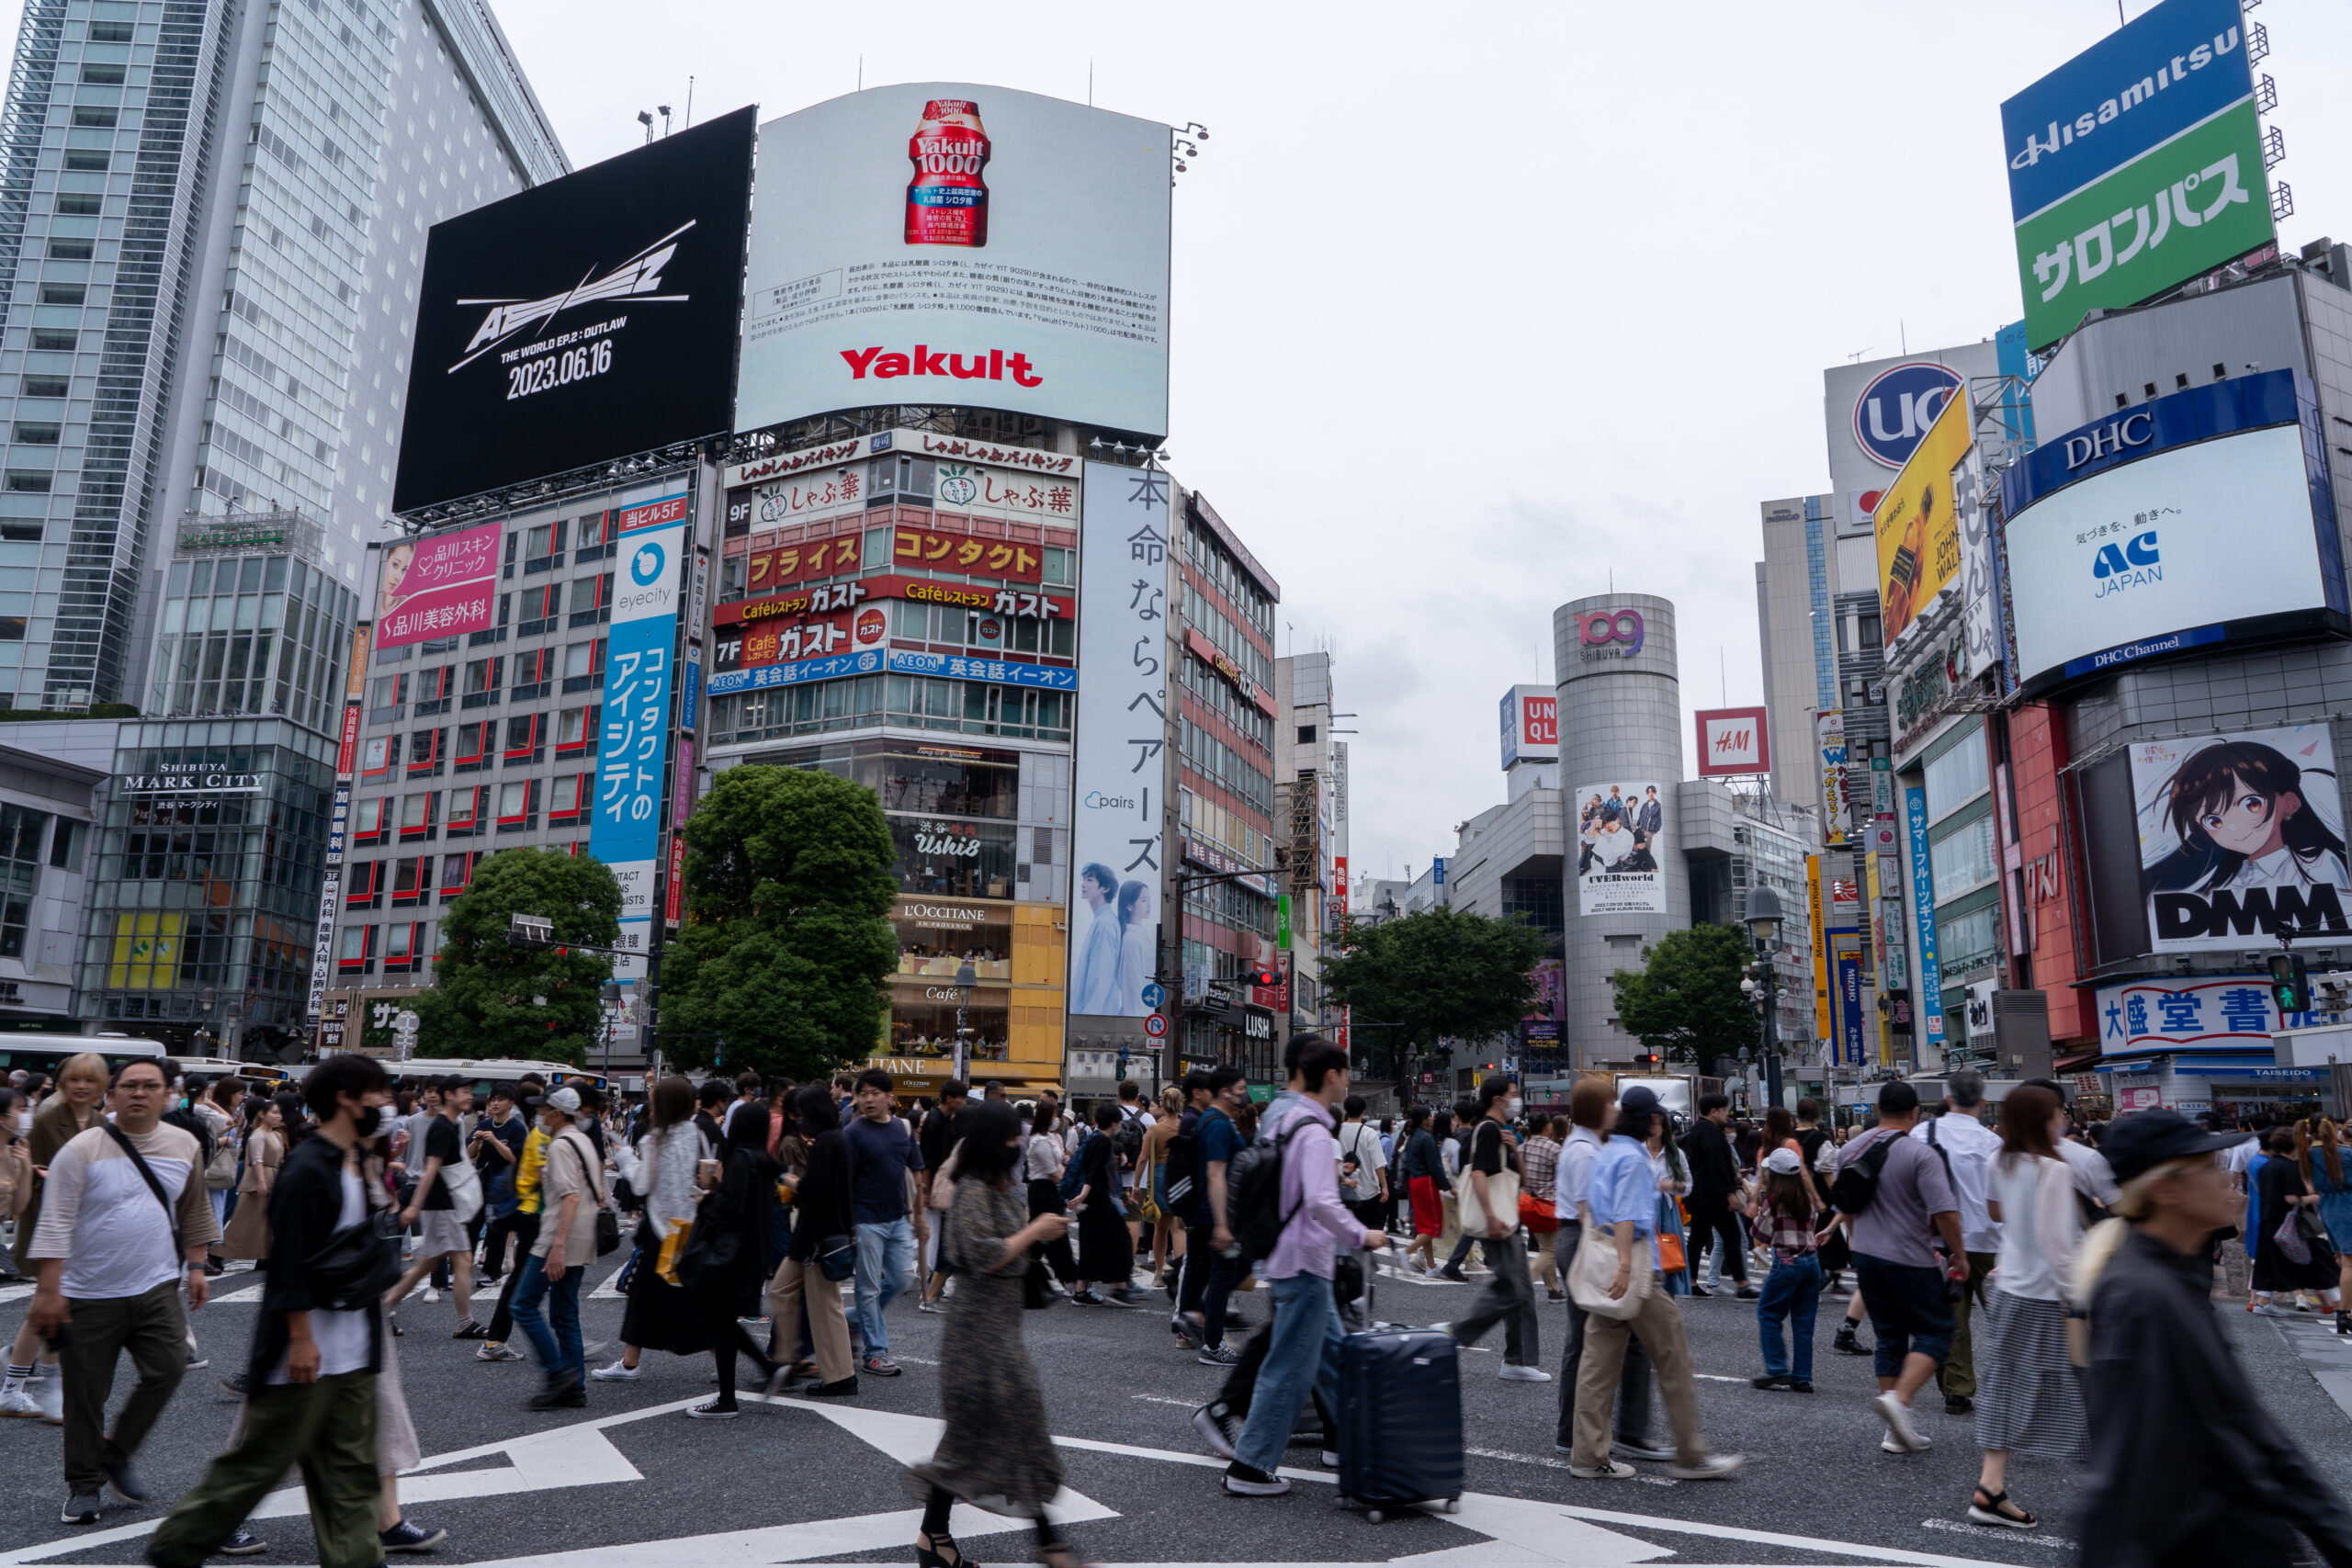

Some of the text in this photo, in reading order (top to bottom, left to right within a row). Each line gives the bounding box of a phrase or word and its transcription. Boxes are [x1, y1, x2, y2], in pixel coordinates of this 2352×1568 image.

[2010, 26, 2239, 170] Hisamitsu
[917, 139, 984, 155] Yakult
[917, 154, 981, 175] 1000
[2033, 152, 2249, 304] サロンパス
[501, 316, 627, 364] THE WORLD EP.2 OUTLAW
[506, 339, 613, 400] 2023.06.16
[840, 344, 1044, 389] Yakult
[922, 434, 1074, 472] しゃぶしゃぶバイキング
[2065, 412, 2154, 470] DHC
[741, 439, 860, 480] しゃぶしゃぶバイキング
[791, 473, 860, 511] しゃぶ葉
[984, 476, 1073, 514] しゃぶ葉
[626, 503, 680, 529] 当ビル5F
[729, 503, 750, 522] 9F
[434, 535, 495, 562] 品川スキン
[751, 538, 858, 581] プライス
[895, 531, 1039, 573] コンタクト
[433, 555, 486, 581] クリニック
[2095, 566, 2163, 599] JAPAN
[619, 586, 672, 611] eyecity
[810, 581, 867, 613] ガスト
[994, 590, 1059, 619] ガスト
[392, 598, 487, 637] 品川美容外科
[860, 625, 883, 636] ガスト
[982, 626, 999, 635] ガスト
[748, 634, 776, 651] Café
[778, 621, 847, 660] ガスト
[1574, 609, 1644, 657] 109
[718, 641, 741, 661] 7F
[747, 649, 775, 661] レストラン
[1580, 649, 1621, 660] SHIBUYA
[2095, 636, 2180, 667] DHC Channel
[713, 655, 876, 689] AEON 英会話イーオン 6F
[896, 653, 1073, 685] AEON 英会話イーオン
[1125, 469, 1168, 872] 本命ならペアーズ
[1530, 703, 1555, 719] UN
[345, 708, 357, 742] 外貨両替
[602, 650, 643, 823] アイシティ
[631, 648, 664, 821] コンタクトの
[1530, 722, 1556, 741] QL
[1716, 728, 1750, 753] H&M
[160, 763, 226, 772] SHIBUYA
[124, 773, 266, 789] MARK CITY
[177, 800, 219, 808] マークシティ
[1099, 793, 1134, 810] pairs
[330, 790, 348, 850] 加藤眼科
[920, 821, 947, 833] 渋谷
[914, 833, 981, 856] Ushi8
[328, 853, 341, 863] 5F
[325, 873, 338, 882] 3F
[1268, 880, 1278, 898] 4F
[1337, 867, 1345, 886] 免税
[1589, 874, 1654, 884] UVERworld
[1911, 815, 1933, 947] サマーフルーツギフト
[322, 898, 334, 918] 内科
[2154, 883, 2350, 940] DMM
[931, 921, 972, 930] PROVENCE
[1815, 909, 1824, 958] Matsumoto
[316, 921, 331, 964] 産婦人科
[925, 987, 958, 1001] Café
[1847, 968, 1856, 1002] MIZUHO
[336, 1003, 347, 1014] 2F
[322, 1021, 345, 1034] 処方せん
[326, 1034, 339, 1044] 受付
[1246, 1013, 1269, 1039] LUSH
